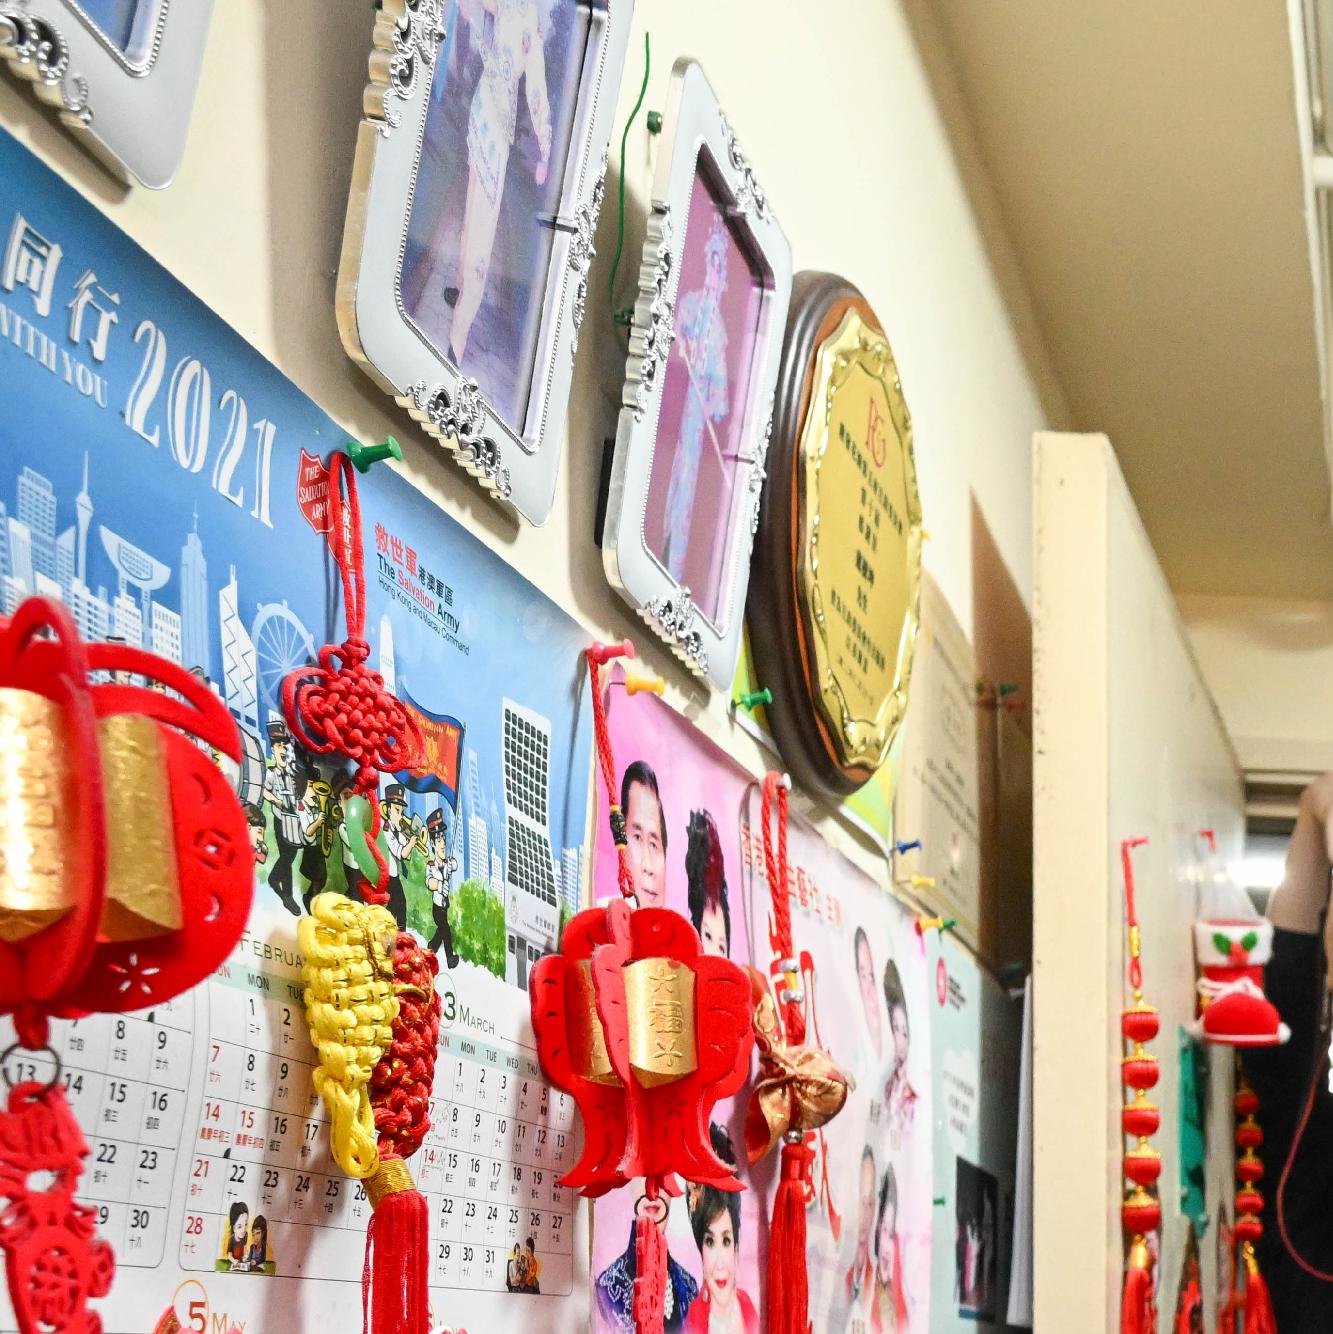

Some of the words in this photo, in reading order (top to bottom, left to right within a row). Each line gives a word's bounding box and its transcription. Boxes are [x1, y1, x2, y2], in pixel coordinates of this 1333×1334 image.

[2, 213, 121, 362] 同行
[62, 350, 108, 409] YOU
[125, 319, 274, 528] 2021
[305, 467, 320, 480] THE
[374, 522, 418, 577] 救世軍
[377, 553, 396, 580] The
[398, 568, 436, 612] Salvation
[437, 603, 460, 634] Army
[378, 576, 396, 600] Hong
[396, 589, 412, 612] Kong
[412, 603, 424, 619] and
[423, 610, 441, 635] Macau
[441, 626, 470, 656] Command
[248, 973, 269, 991] MON
[250, 999, 254, 1016] 1
[443, 991, 456, 1021] 3
[458, 1005, 495, 1036] MARCH
[117, 1020, 125, 1039] 8
[248, 1054, 255, 1071] 8
[461, 1041, 475, 1054] MON
[486, 1050, 496, 1062] TUE
[506, 1056, 518, 1069] WED
[527, 1063, 538, 1076] THU
[64, 1072, 83, 1094] 14
[480, 1069, 485, 1083] 2
[542, 1088, 546, 1101] 5
[242, 1111, 254, 1128] 15
[475, 1114, 480, 1127] 9
[538, 1130, 546, 1144] 12
[97, 1144, 116, 1163] 22
[449, 1154, 457, 1168] 15
[514, 1167, 521, 1181] 18
[194, 1159, 209, 1177] 21
[296, 1175, 310, 1192] 24
[442, 1199, 452, 1213] 22
[509, 1209, 518, 1223] 25
[439, 1244, 450, 1258] 29
[189, 1301, 206, 1332] 5
